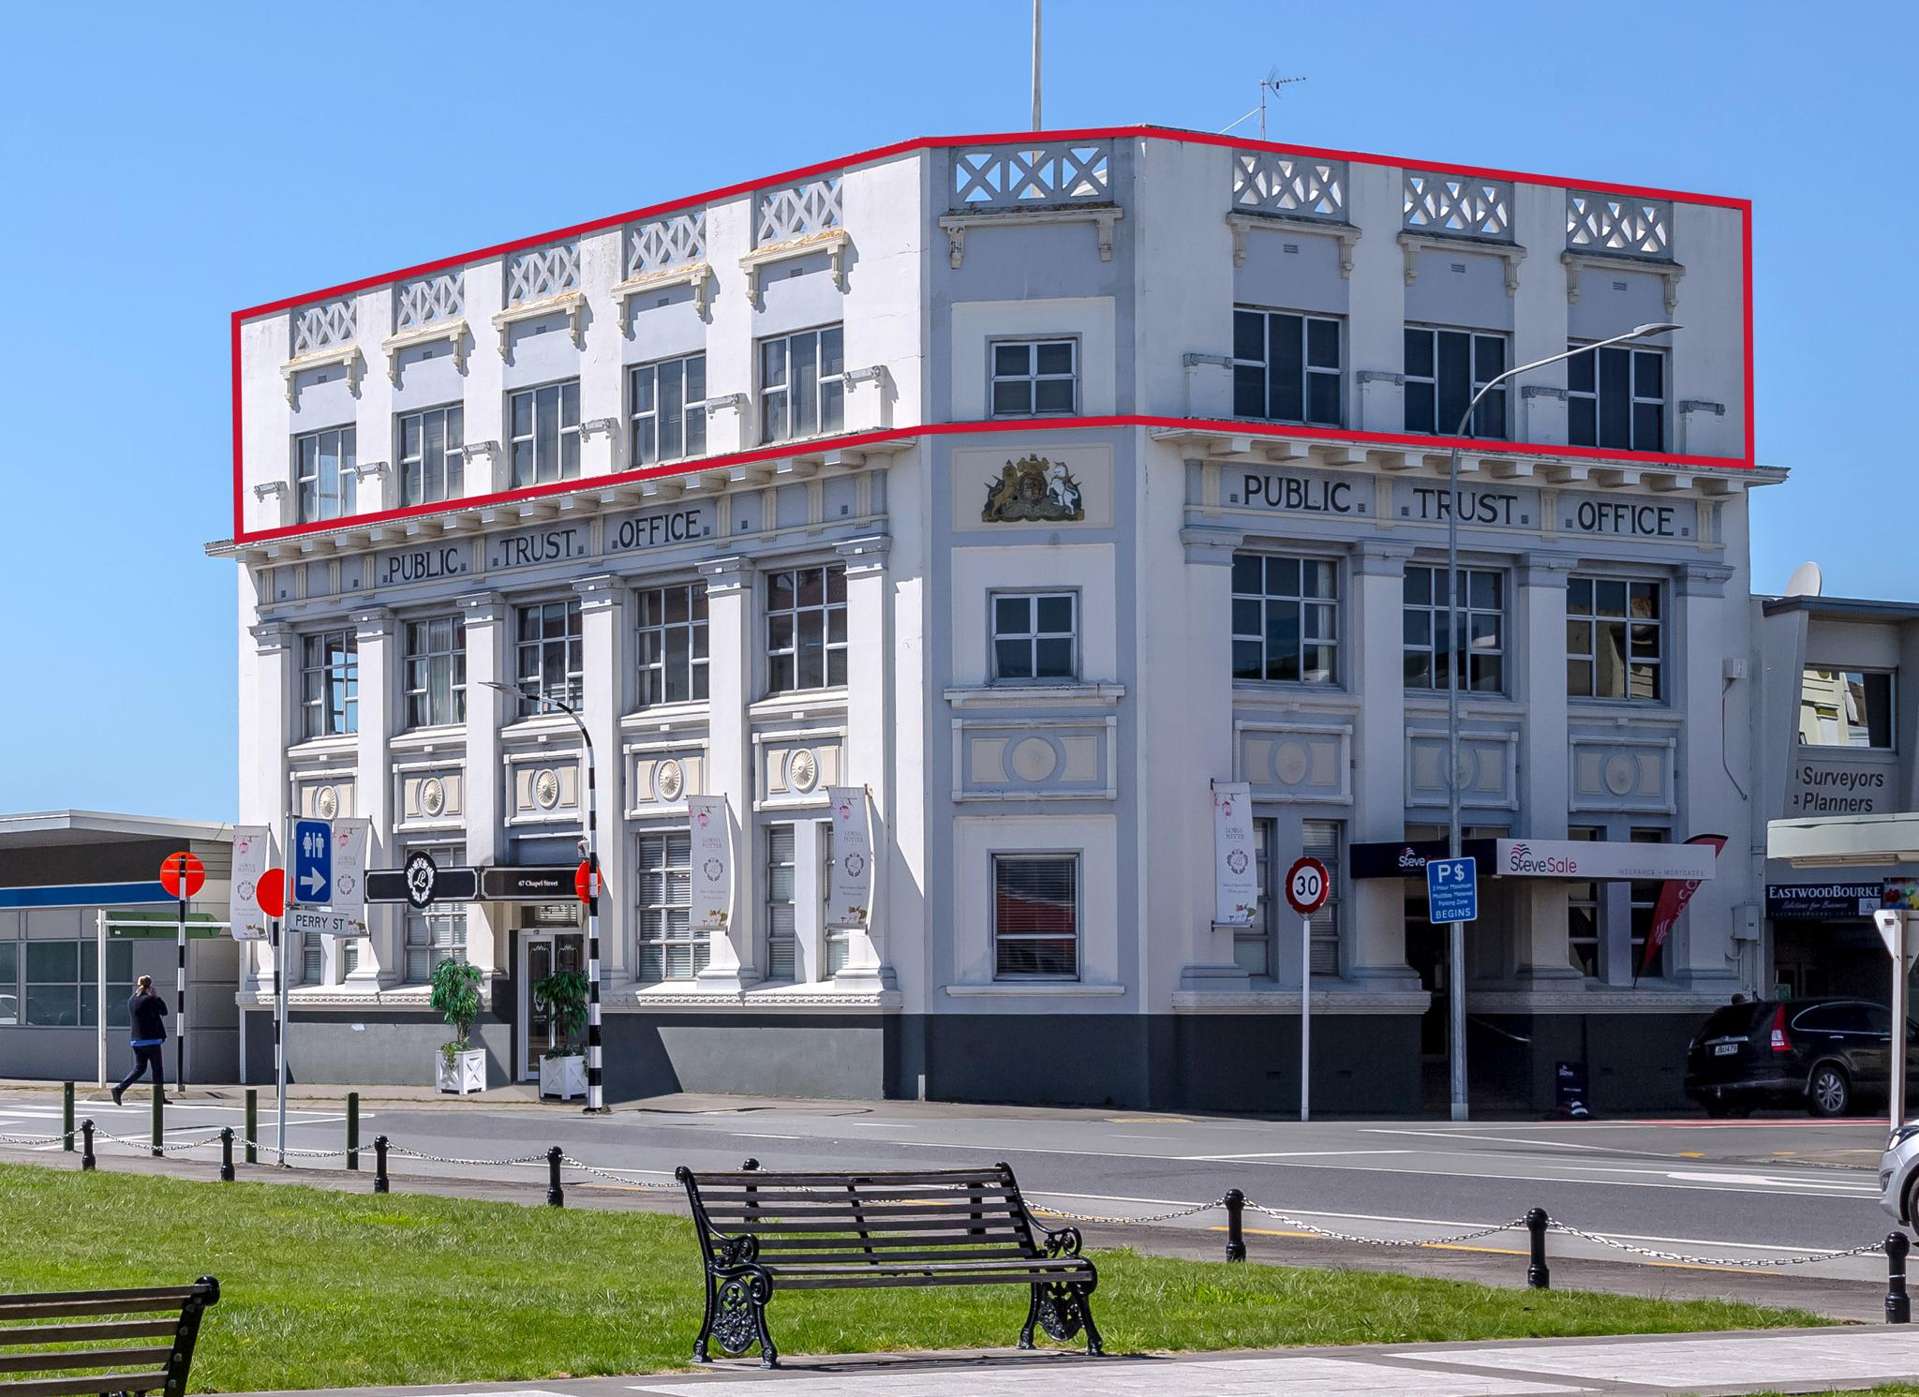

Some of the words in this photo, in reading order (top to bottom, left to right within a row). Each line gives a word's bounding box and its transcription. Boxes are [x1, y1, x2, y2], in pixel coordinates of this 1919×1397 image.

[1244, 475, 1351, 513] PUBLIC
[1413, 487, 1518, 524] TRUST
[1577, 501, 1674, 537] OFFICE
[389, 549, 458, 583] PUBLIC
[500, 529, 577, 566] TRUST
[618, 510, 701, 550] OFFICE
[1802, 766, 1884, 791] Surveyors
[1802, 792, 1873, 812] Planners
[1295, 875, 1320, 896] 30
[295, 914, 328, 929] PERRY
[332, 918, 345, 930] ST
[1435, 907, 1472, 919] BEGINS
